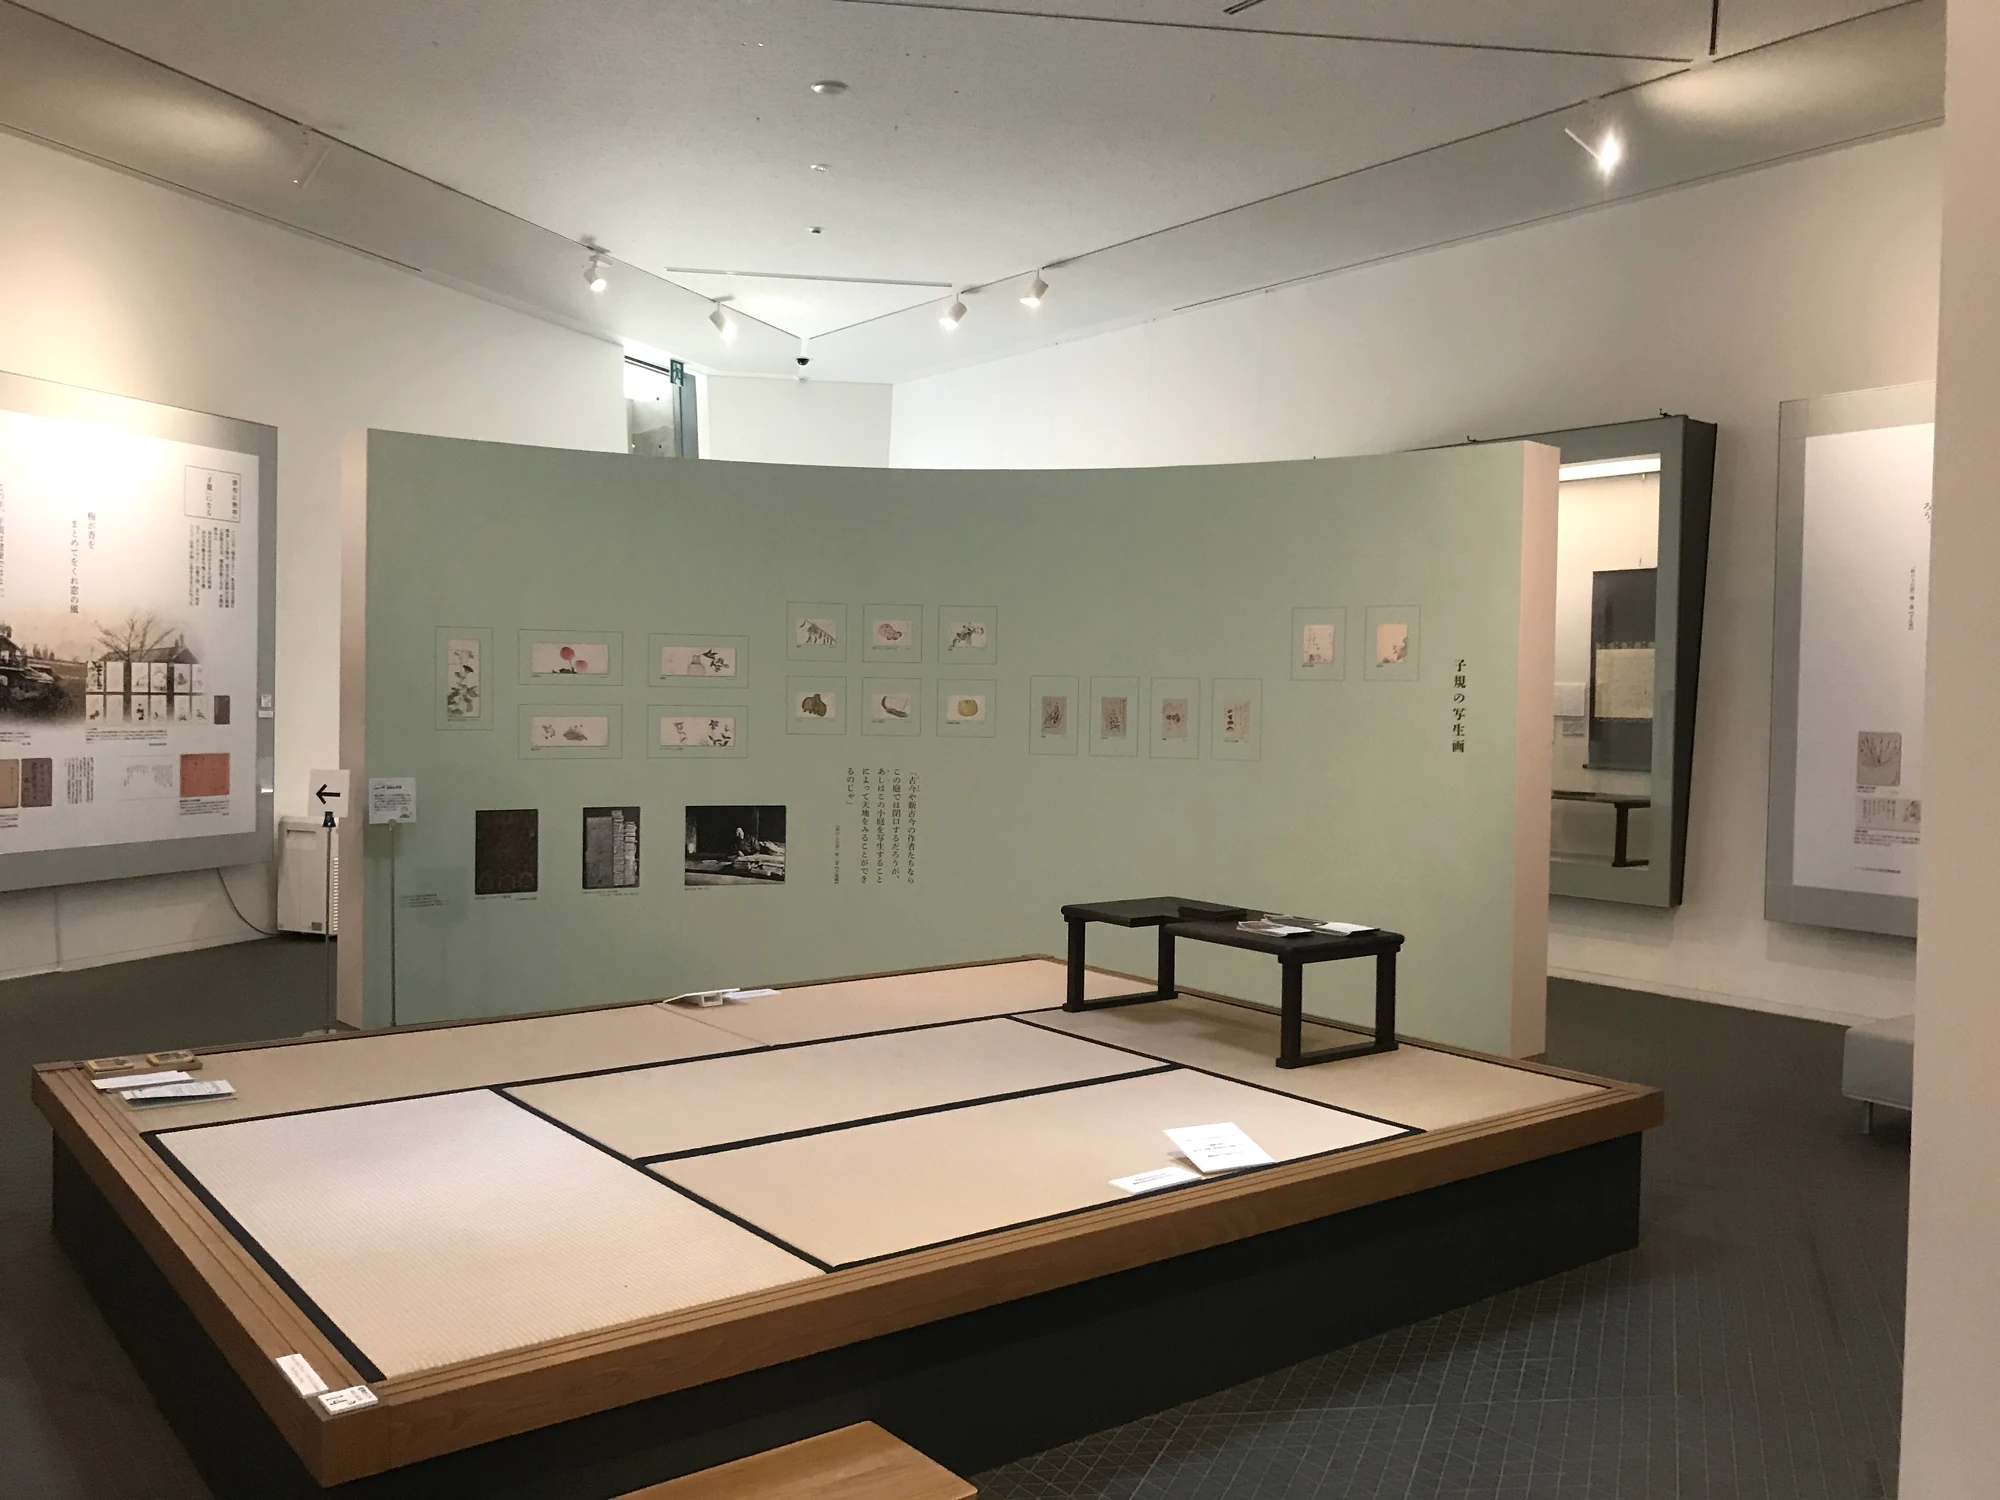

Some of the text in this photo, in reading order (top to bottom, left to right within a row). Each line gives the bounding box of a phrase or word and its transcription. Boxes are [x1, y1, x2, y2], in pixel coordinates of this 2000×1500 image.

[1451, 658, 1467, 753] 子規の写生画
[846, 767, 855, 805] るのじゃ」
[860, 768, 870, 884] によって天地をみることができ
[876, 768, 886, 884] あしはこの小庭を写生すること
[892, 768, 902, 879] この庭では閉口するだろうが、
[907, 772, 918, 884] 「古今や新古今の作者たちなら
